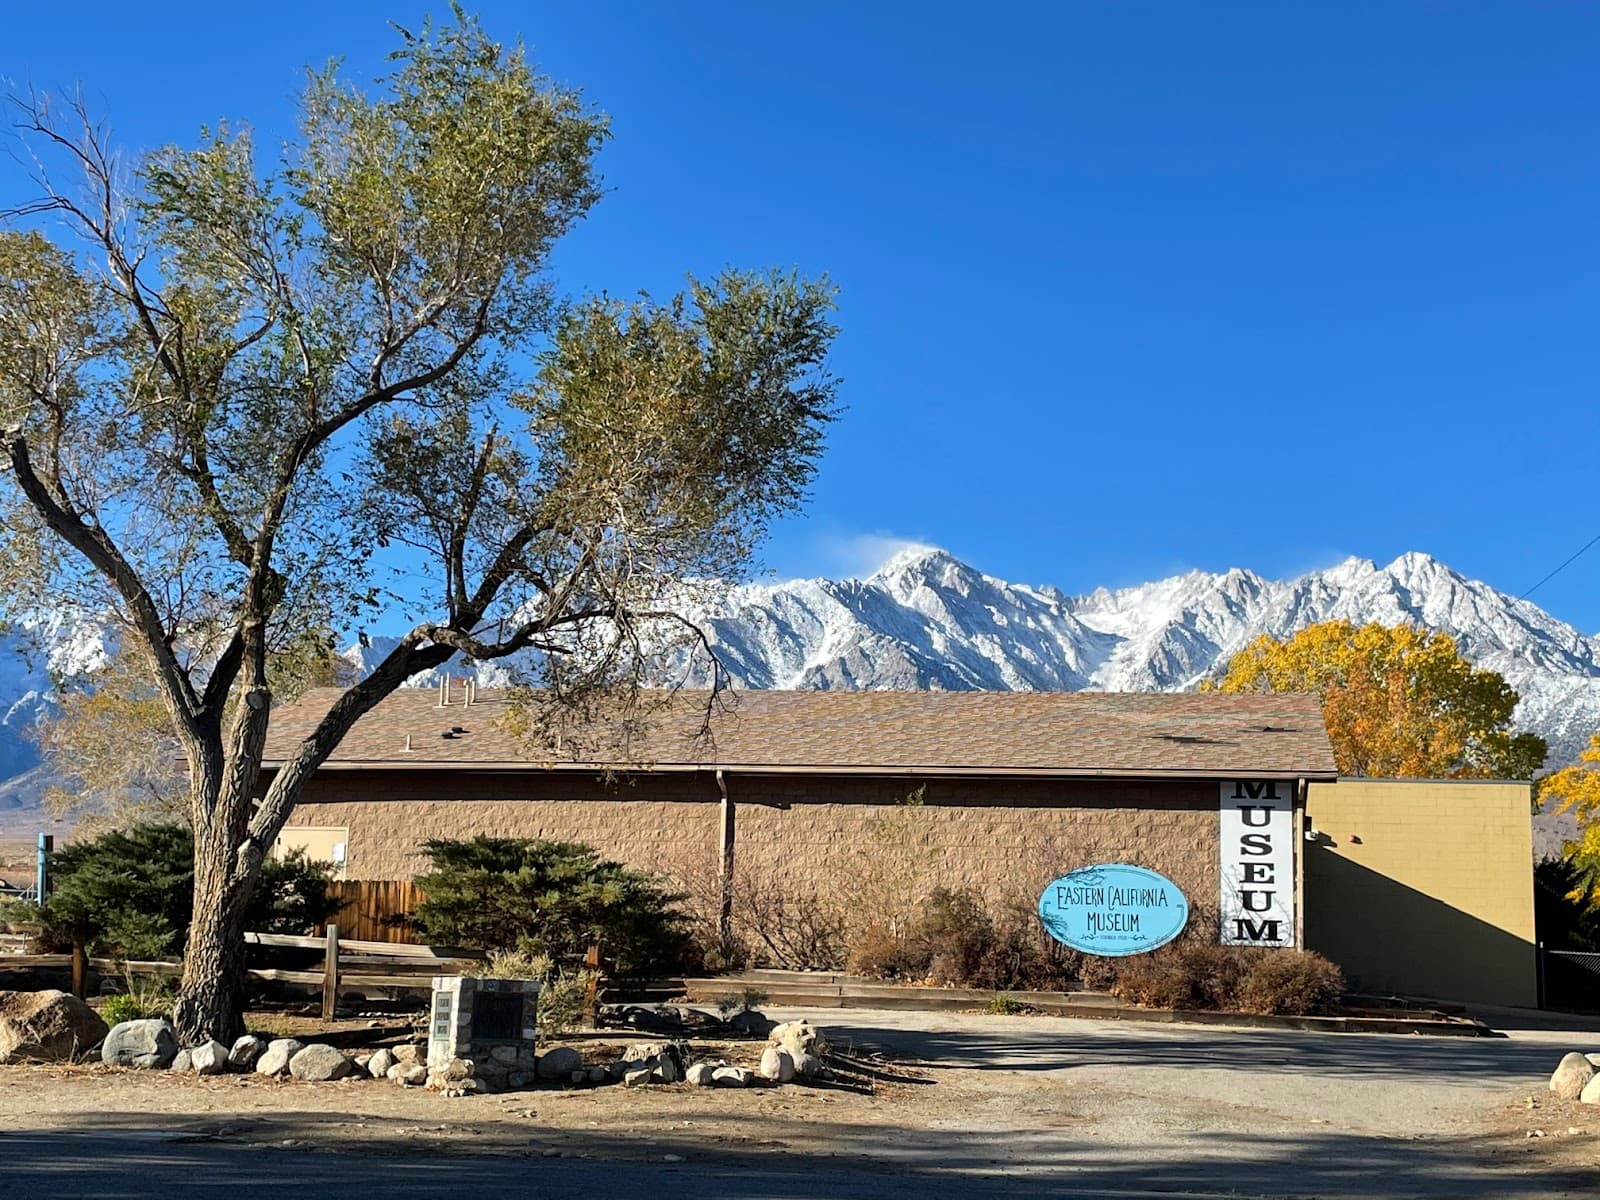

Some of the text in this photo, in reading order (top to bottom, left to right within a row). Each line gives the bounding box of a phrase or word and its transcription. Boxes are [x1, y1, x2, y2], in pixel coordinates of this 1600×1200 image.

[1230, 781, 1283, 942] MUSEUM
[1056, 885, 1168, 911] EASTERN CALIFORNIA
[1087, 912, 1140, 935] MUSEUM
